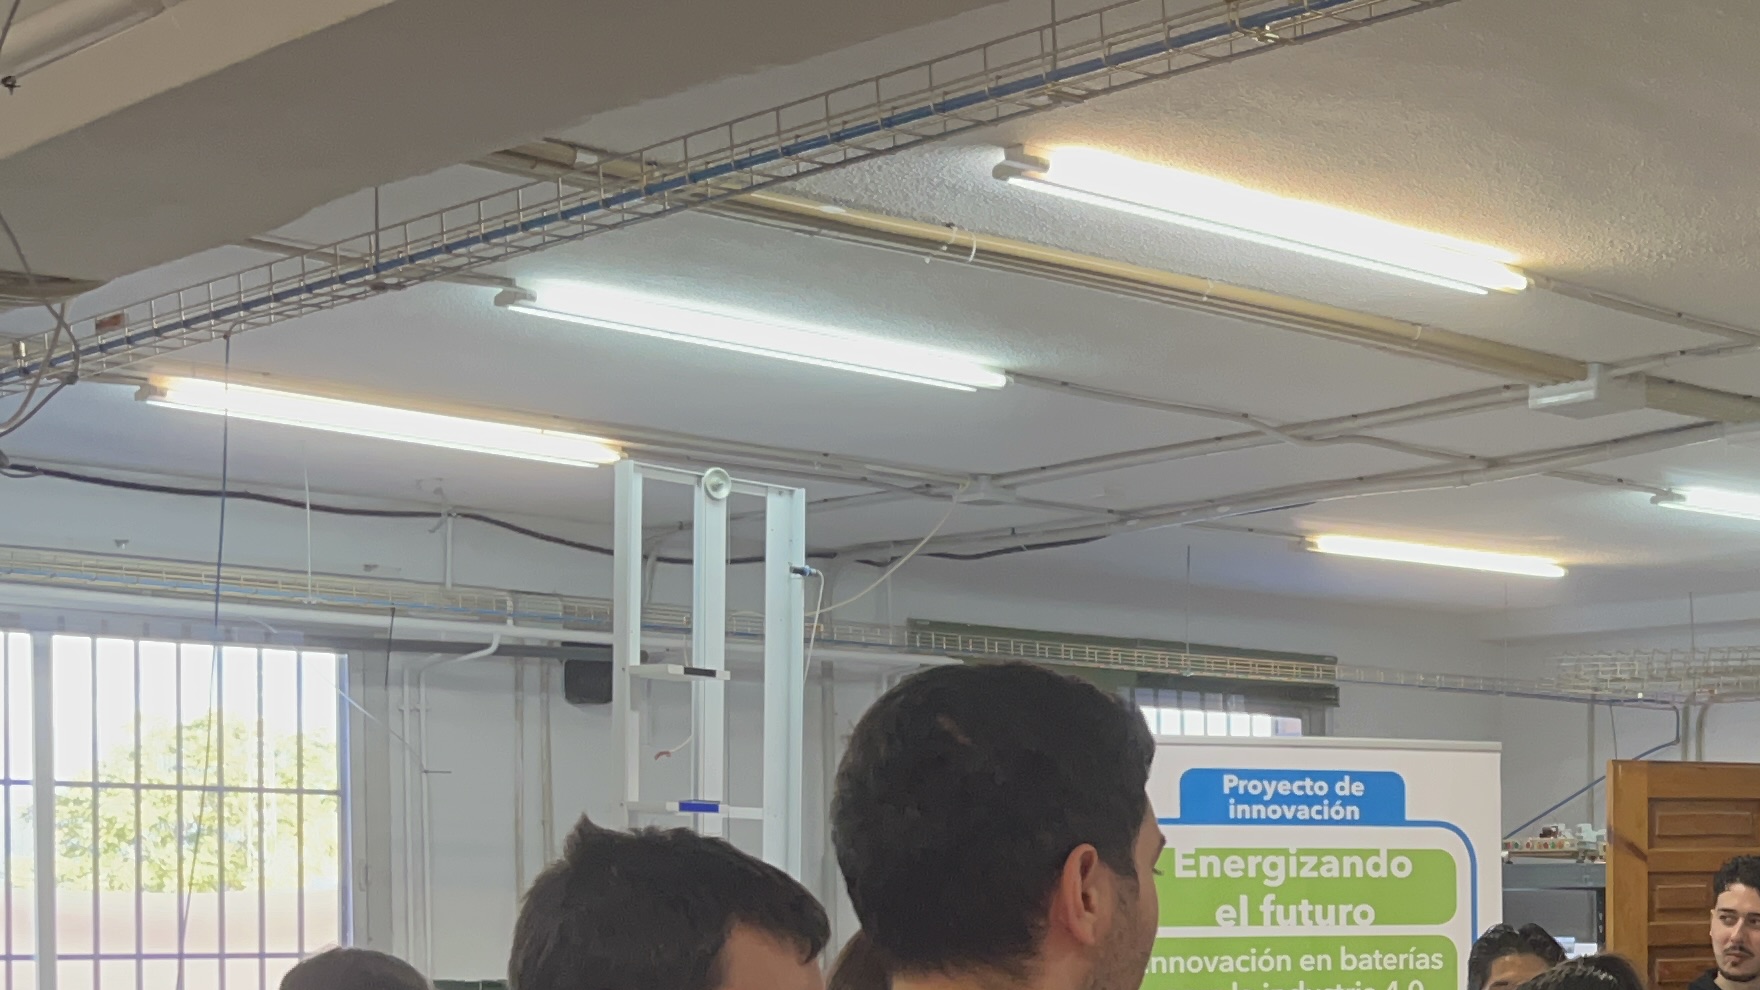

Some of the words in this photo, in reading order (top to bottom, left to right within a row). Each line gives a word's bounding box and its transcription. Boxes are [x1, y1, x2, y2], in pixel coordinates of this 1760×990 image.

[1222, 774, 1329, 801] Proyecto
[1335, 775, 1365, 797] de
[1229, 799, 1360, 821] innovación
[1174, 848, 1413, 887] Energizando
[1215, 894, 1249, 927] el
[1260, 894, 1376, 927] futuro
[1144, 947, 1291, 974] nnovación
[1300, 950, 1333, 972] en
[1340, 946, 1444, 972] baterías
